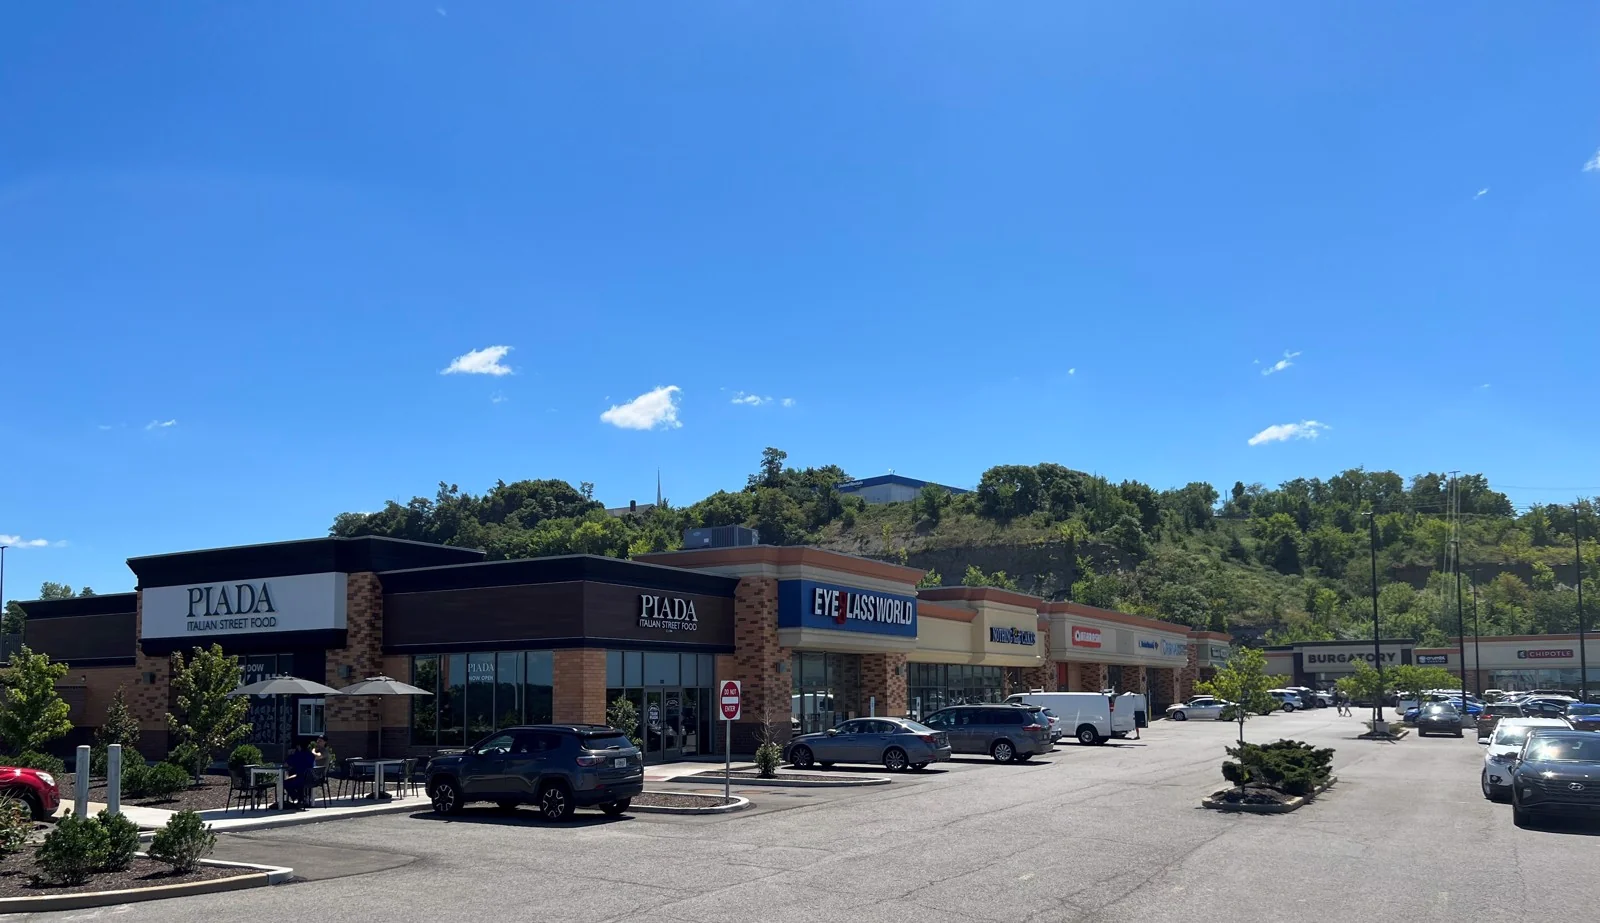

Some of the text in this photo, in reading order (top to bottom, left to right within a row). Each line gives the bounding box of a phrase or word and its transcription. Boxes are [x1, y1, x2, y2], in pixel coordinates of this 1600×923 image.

[186, 582, 275, 617] PIADA
[640, 594, 698, 622] PIADA
[876, 597, 913, 625] WORLD
[187, 617, 276, 631] ITALIAN STREET FOOD
[639, 618, 698, 631] ITALIAN STREET FOOD
[1308, 652, 1396, 664] BURGATORY
[1529, 650, 1572, 658] CHIPOTLE
[467, 662, 495, 673] PIADA
